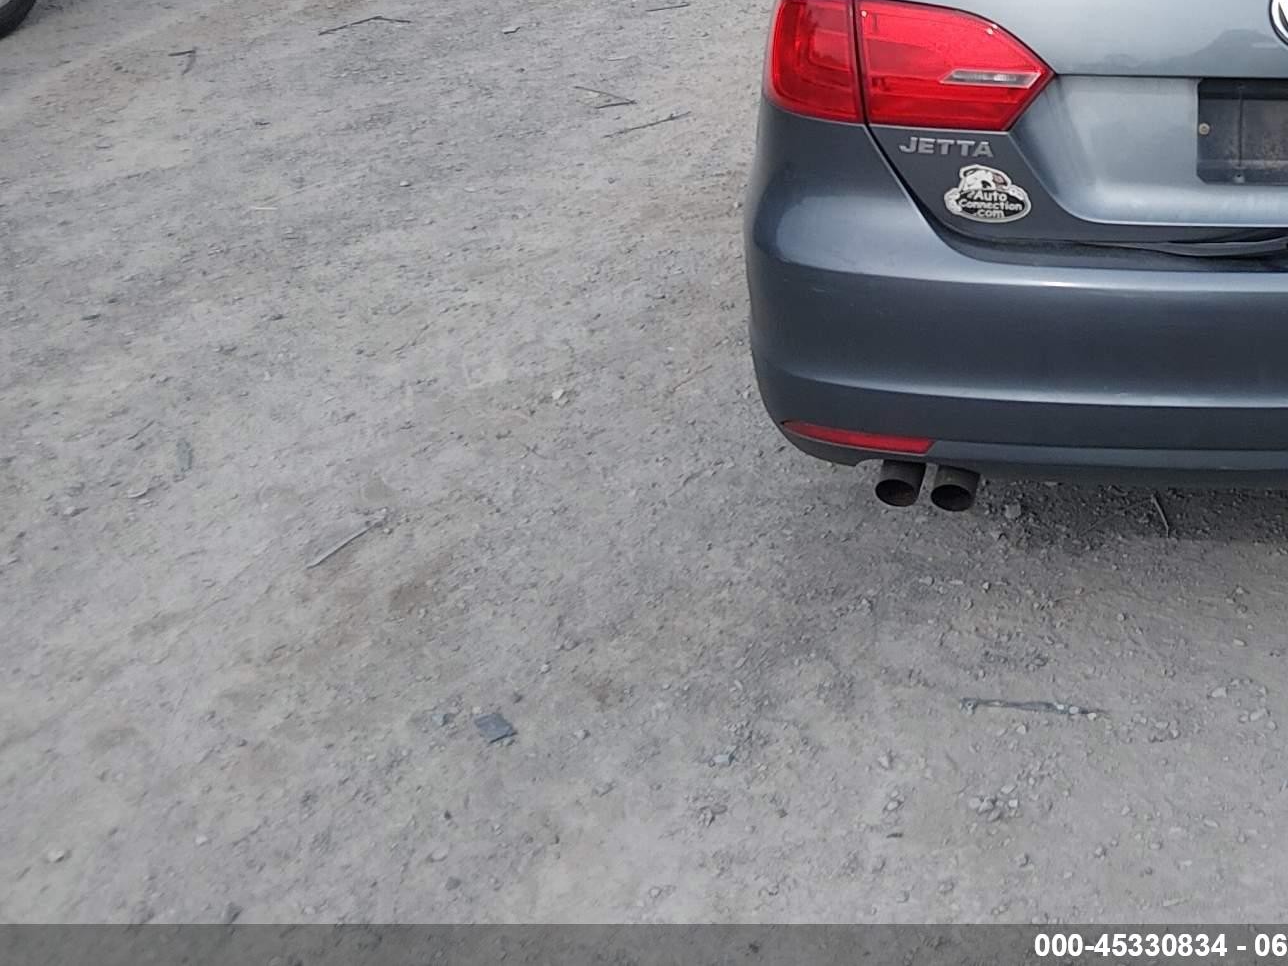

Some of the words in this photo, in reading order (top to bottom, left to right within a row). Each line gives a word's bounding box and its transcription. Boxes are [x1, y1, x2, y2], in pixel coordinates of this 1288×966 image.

[900, 136, 993, 158] JETTA
[973, 190, 1008, 202] Auto
[958, 199, 1023, 211] Connection
